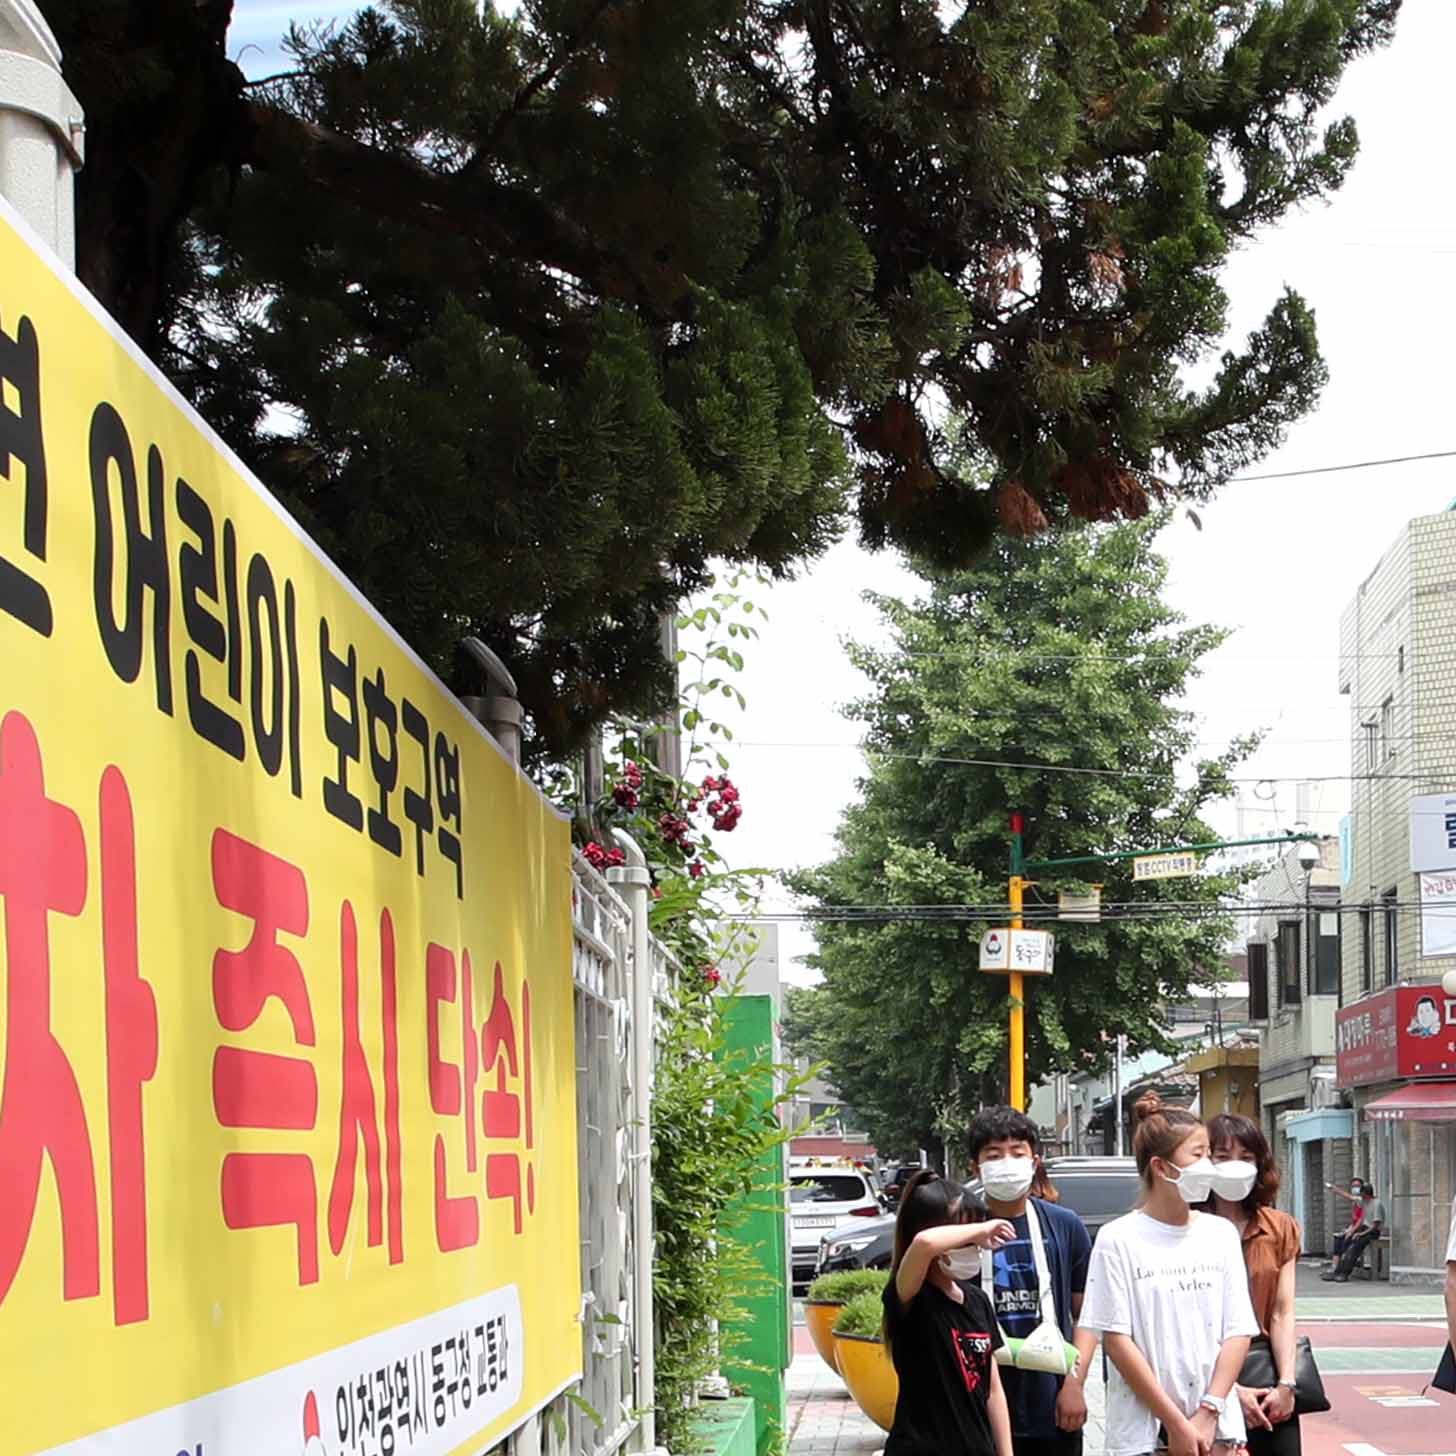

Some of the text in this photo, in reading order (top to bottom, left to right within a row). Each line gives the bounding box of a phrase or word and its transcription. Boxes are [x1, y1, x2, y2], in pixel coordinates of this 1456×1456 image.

[89, 400, 302, 799] 어린이
[319, 615, 464, 899] 보호구역
[211, 826, 404, 1286] 즉시
[425, 942, 534, 1253] 단속!
[995, 1290, 1039, 1304] UNDE
[997, 1302, 1036, 1313] ARMO
[432, 1330, 472, 1427] 동구청
